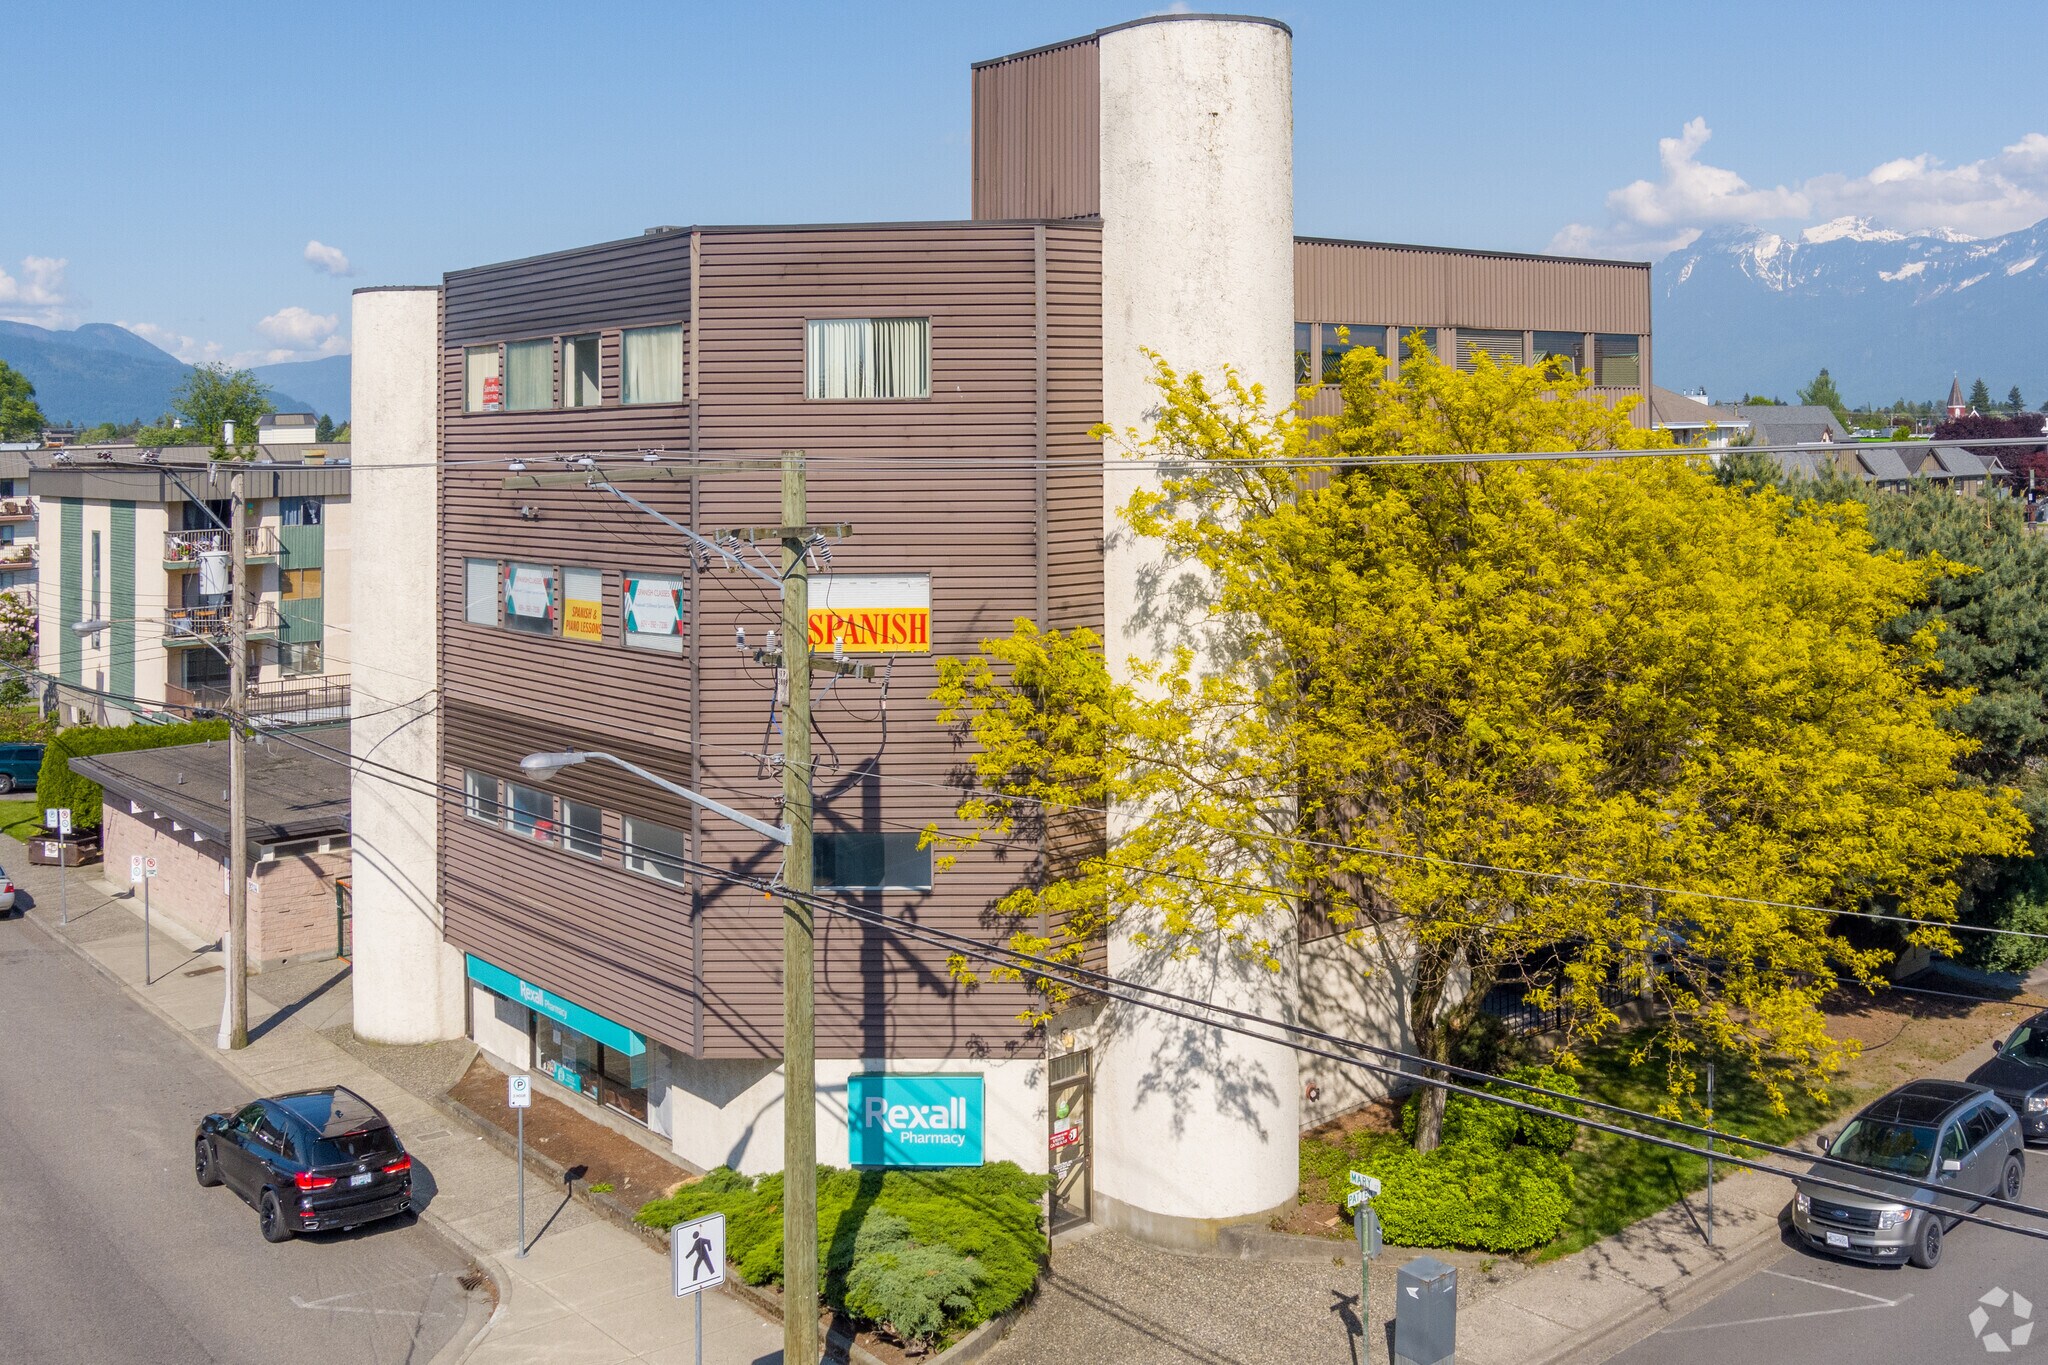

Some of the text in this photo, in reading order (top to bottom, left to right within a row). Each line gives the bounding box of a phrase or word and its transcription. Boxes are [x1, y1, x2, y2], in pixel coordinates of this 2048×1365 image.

[572, 606, 597, 619] SPANISH &
[566, 620, 602, 634] PIANO LESSONS
[808, 614, 927, 644] SPANISH
[520, 980, 567, 1019] Rexall Pharmacy
[865, 1096, 966, 1133] Rexall
[901, 1132, 965, 1147] Pharmacy
[1351, 1172, 1371, 1188] MARY
